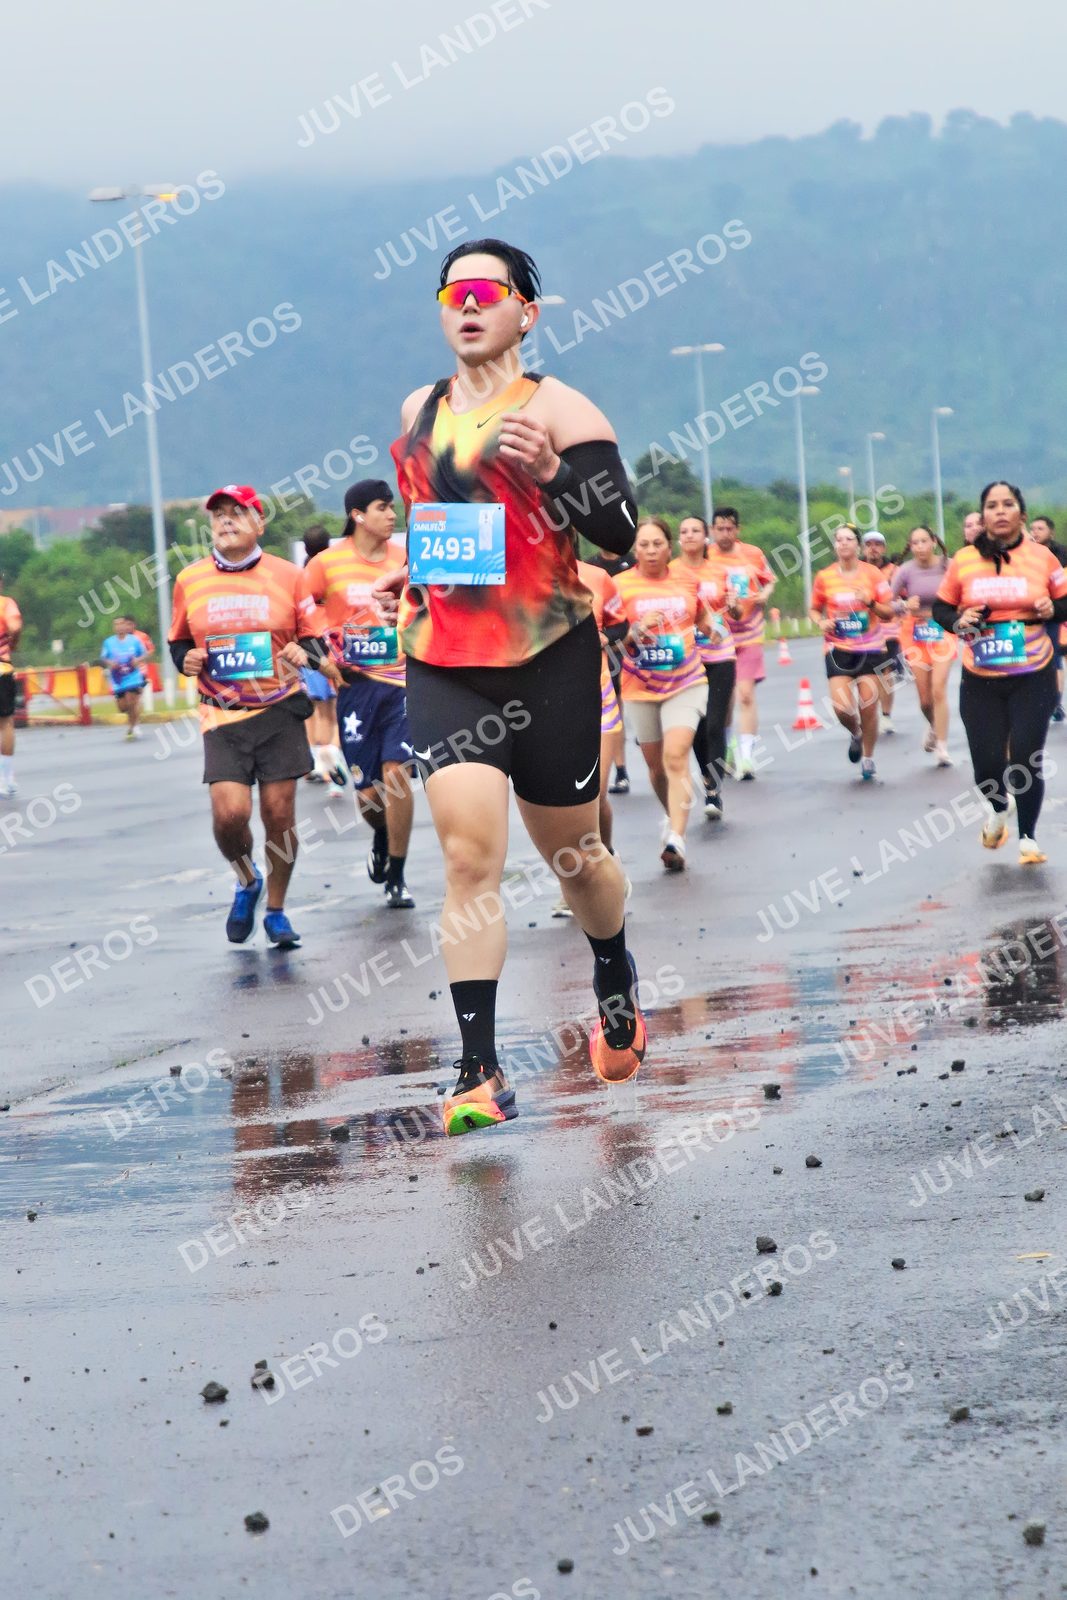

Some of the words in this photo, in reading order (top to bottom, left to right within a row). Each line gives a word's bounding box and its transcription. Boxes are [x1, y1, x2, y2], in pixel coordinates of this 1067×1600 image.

[421, 537, 476, 560] 2493
[352, 641, 388, 655] 1203
[981, 639, 1014, 654] 1276
[217, 652, 256, 668] 1474
[642, 649, 673, 661] 1392
